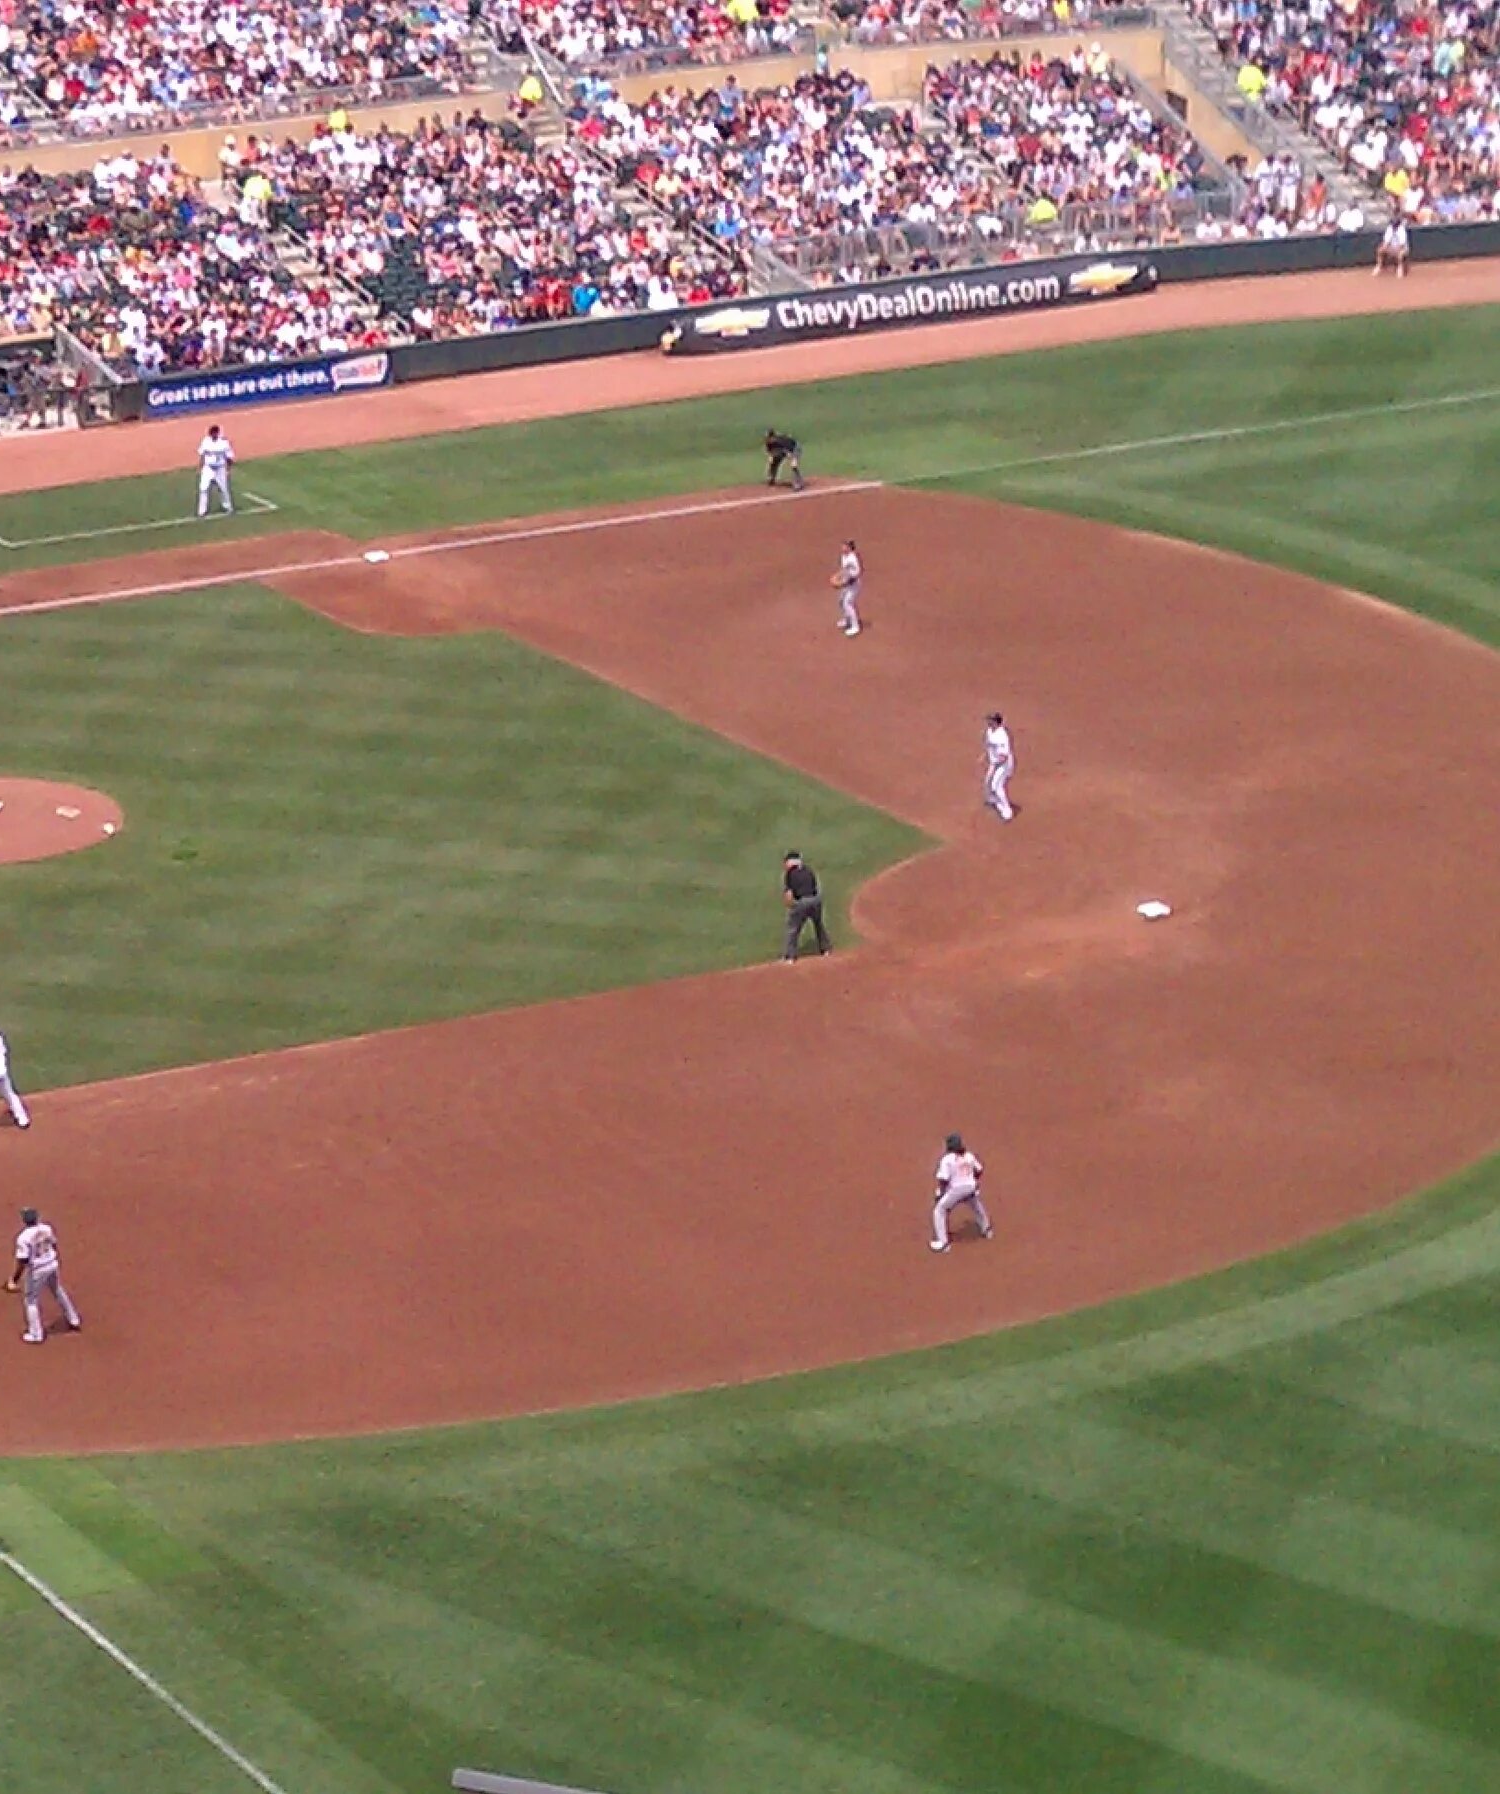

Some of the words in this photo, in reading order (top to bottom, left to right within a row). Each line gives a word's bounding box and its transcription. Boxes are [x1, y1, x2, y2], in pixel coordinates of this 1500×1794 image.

[776, 275, 1060, 329] ChevyDealOnline.com
[148, 386, 189, 407] Great
[192, 382, 230, 401] seats
[233, 379, 256, 395] are
[258, 373, 283, 391] out
